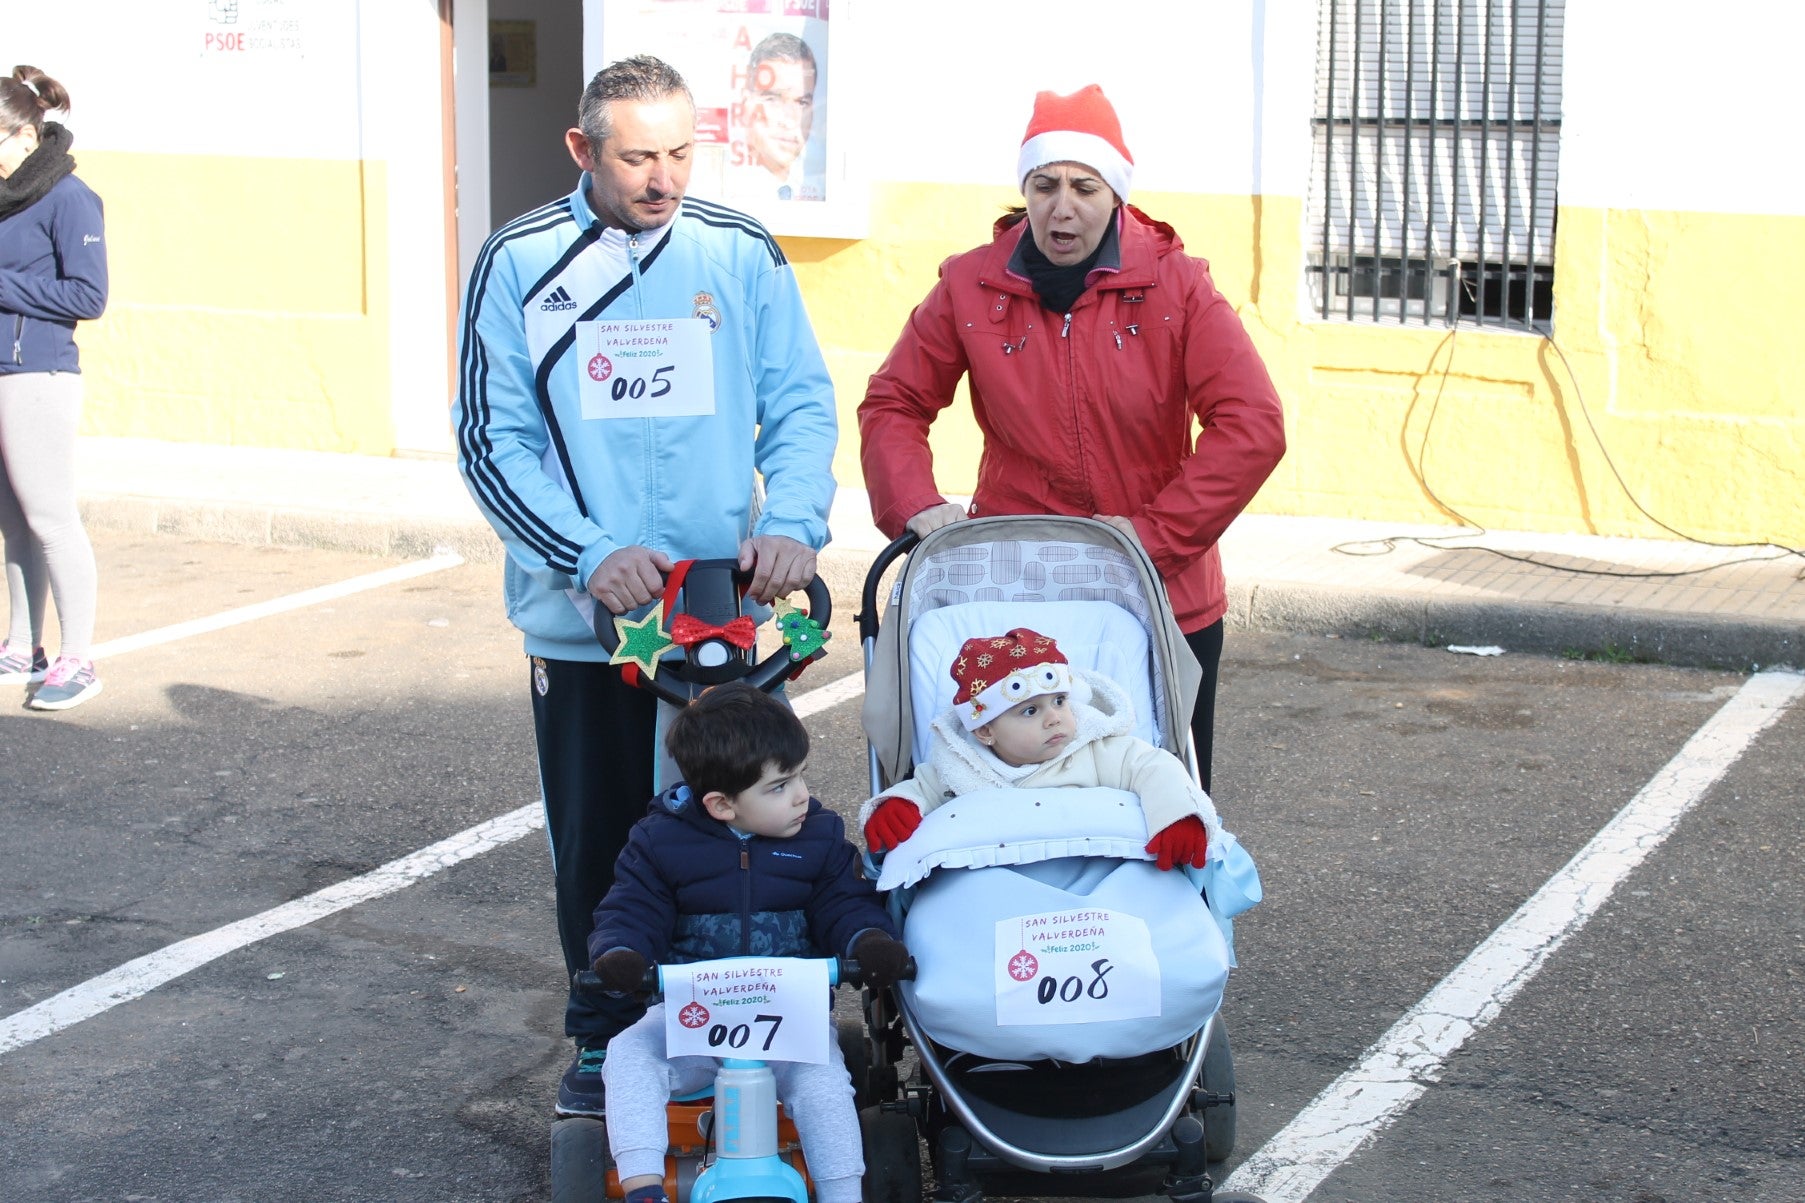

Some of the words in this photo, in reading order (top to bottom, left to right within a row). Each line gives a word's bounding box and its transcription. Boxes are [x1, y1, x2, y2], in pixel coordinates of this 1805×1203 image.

[205, 32, 245, 51] PSOE
[540, 301, 578, 312] adidas
[600, 325, 620, 333] SAN
[624, 323, 674, 333] SILVESTRE
[606, 335, 669, 346] VALVERDEÑA
[611, 365, 675, 402] 005
[1025, 917, 1047, 928] SAN
[1052, 912, 1111, 925] SILVESTRE
[1031, 926, 1105, 942] VALVERDEÑA
[696, 973, 719, 983] SAN
[724, 968, 784, 980] SILVESTRE
[1037, 958, 1114, 1005] 008
[703, 982, 777, 996] VALVERDEÑA
[708, 1014, 783, 1052] 007
